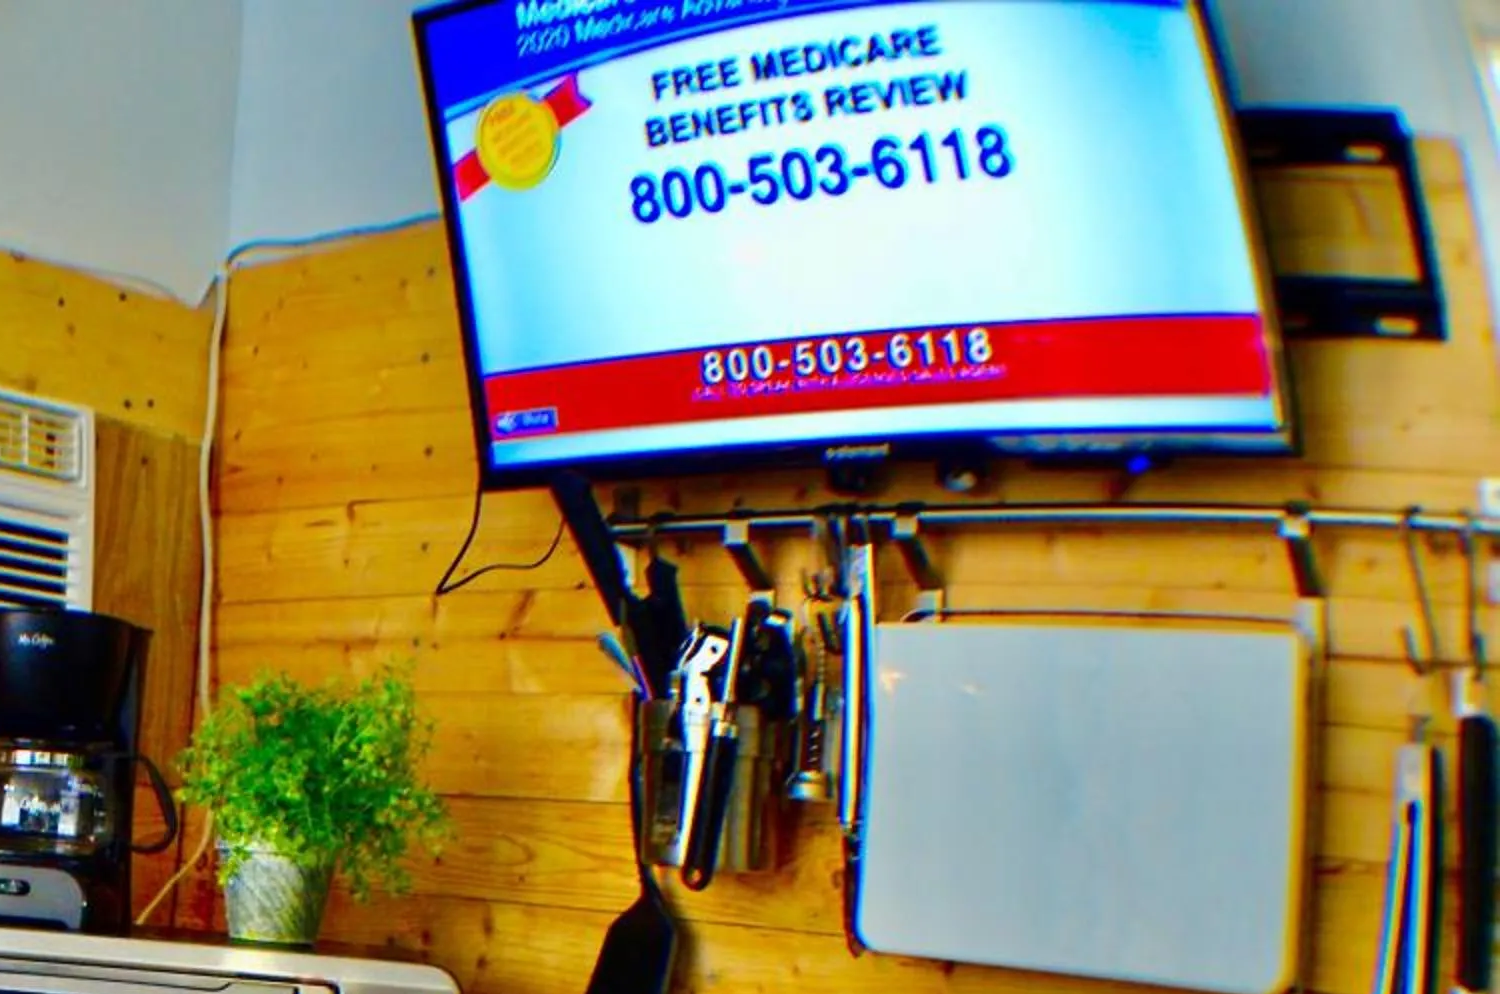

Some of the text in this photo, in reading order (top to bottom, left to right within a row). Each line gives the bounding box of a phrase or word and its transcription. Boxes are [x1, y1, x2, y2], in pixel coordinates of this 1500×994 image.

[516, 24, 570, 58] 2020
[651, 25, 943, 101] FREE MEDICARE
[645, 69, 969, 148] BENEFITS REVIEW
[630, 123, 1014, 224] 800-503-6118
[702, 327, 993, 385] 800-503-6118
